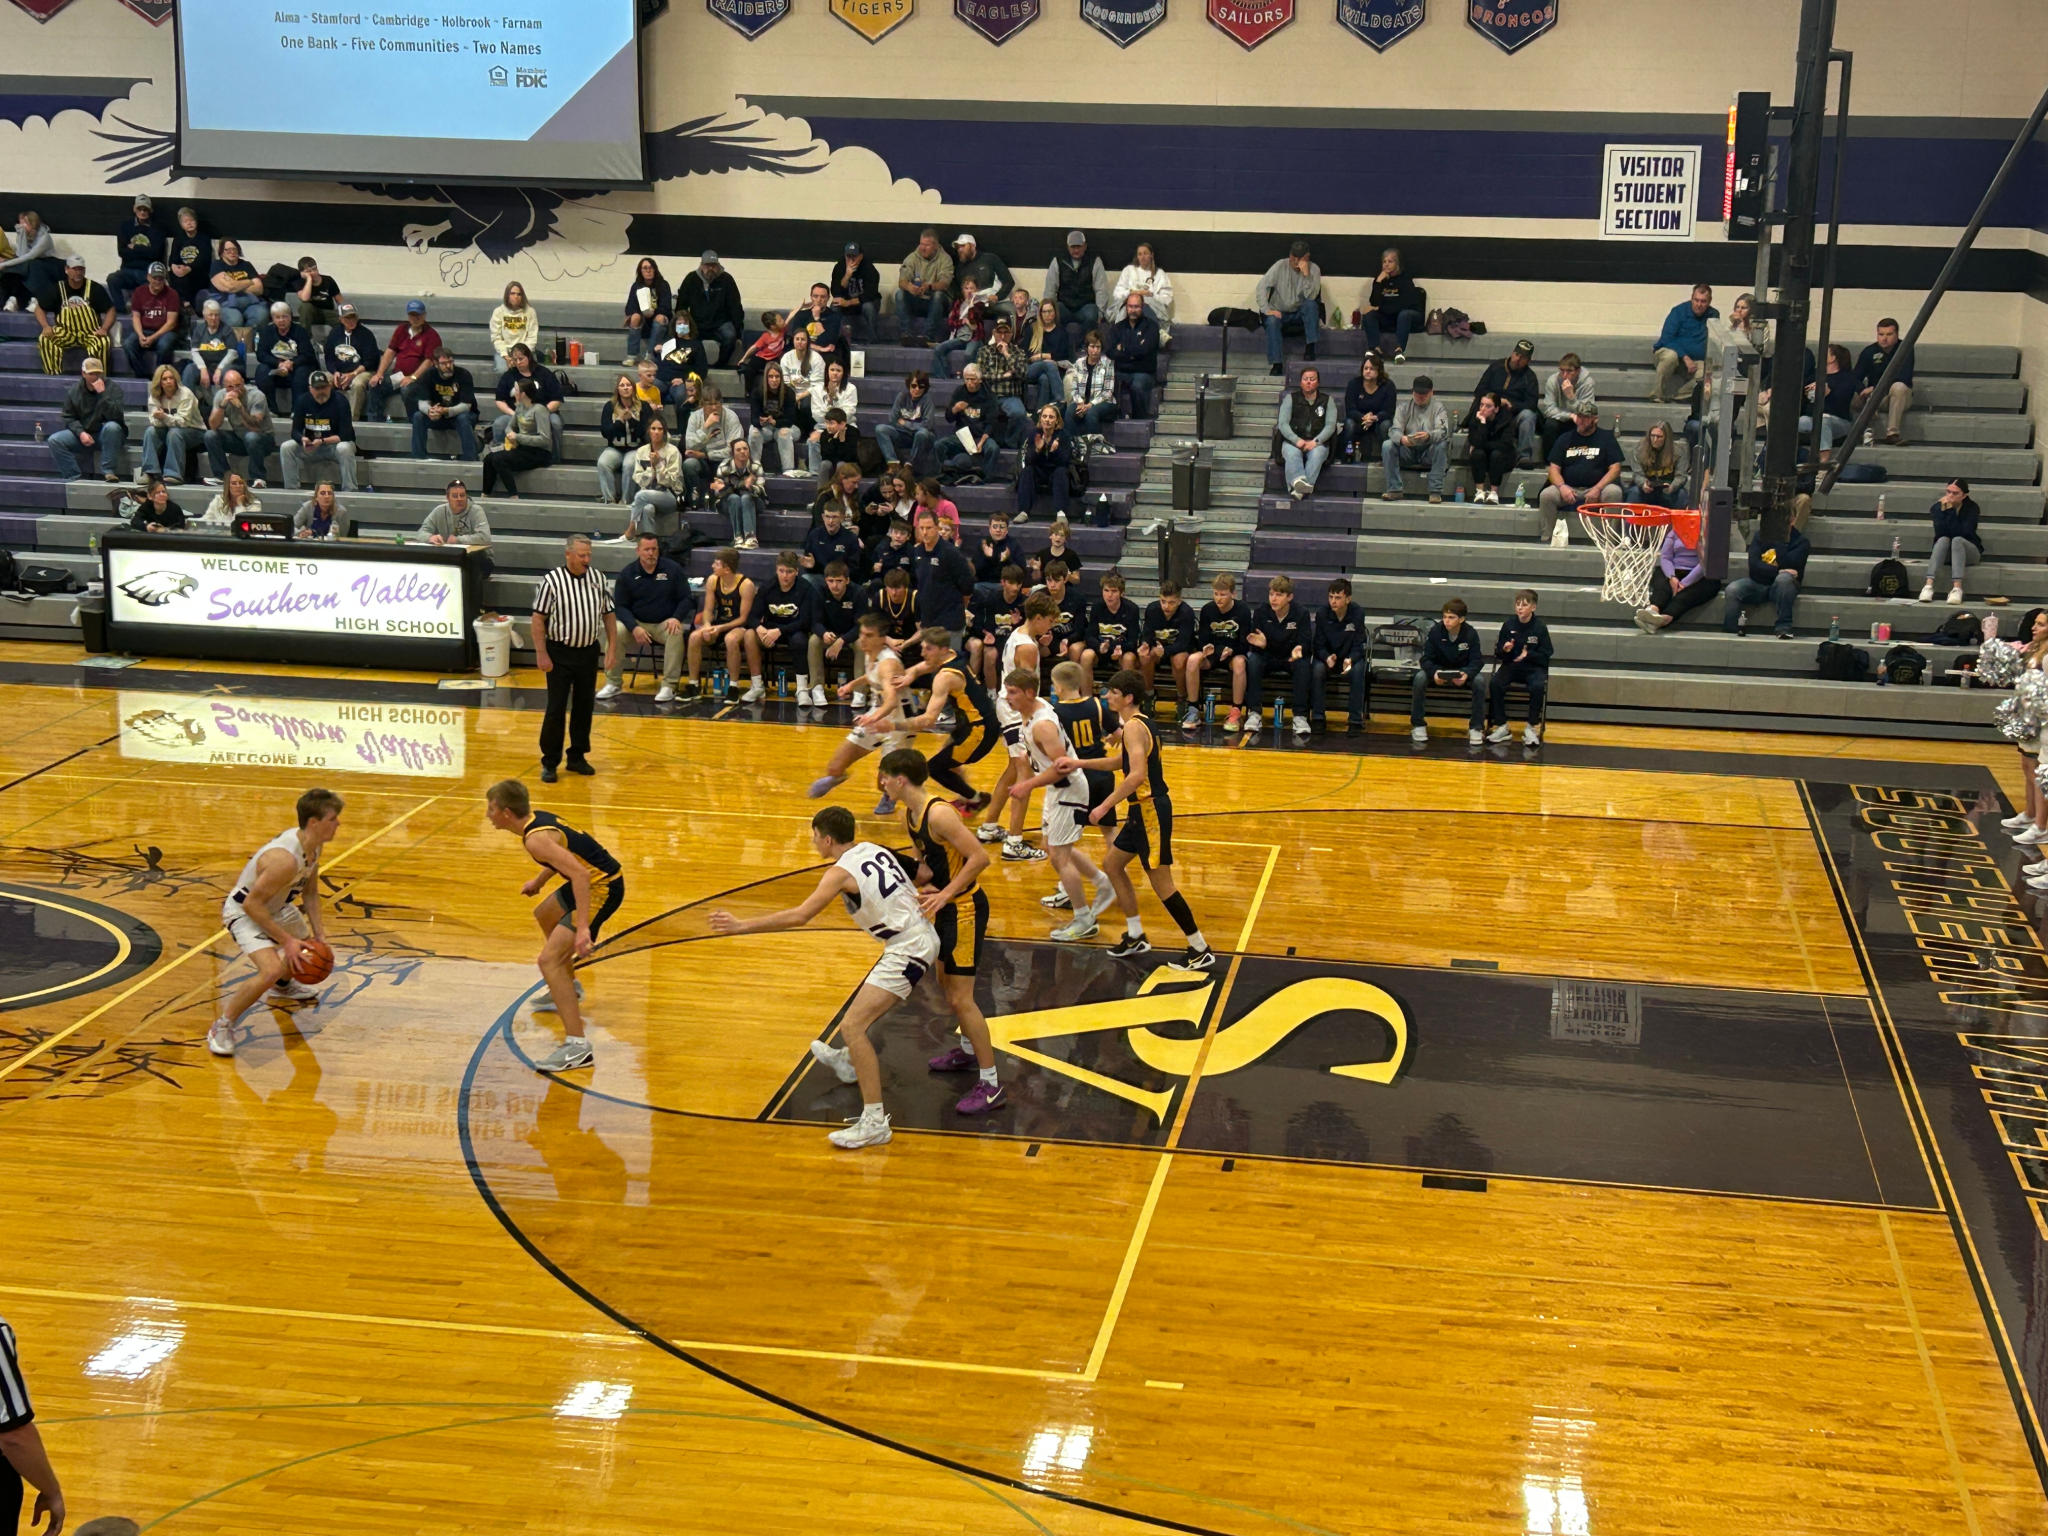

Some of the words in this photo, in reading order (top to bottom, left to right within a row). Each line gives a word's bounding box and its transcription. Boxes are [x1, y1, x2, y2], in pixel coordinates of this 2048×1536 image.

[715, 0, 785, 15] RAIDERS
[842, 0, 904, 15] TIGERS
[966, 0, 1032, 19] EAGLES
[1218, 6, 1284, 24] SAILORS
[1342, 4, 1422, 28] WILDCATS
[1473, 5, 1554, 28] BRONCOS
[274, 11, 300, 24] Alma
[311, 13, 361, 25] Stamford
[372, 14, 430, 28] Cambridge
[442, 15, 491, 29] Holbrook
[502, 17, 542, 30] Farnam
[281, 36, 304, 49] One
[308, 36, 338, 50] Bank
[351, 37, 376, 50] Five
[379, 38, 460, 53] Communities
[473, 40, 496, 55] Two
[501, 41, 542, 55] Names
[516, 75, 548, 88] FDIC
[1620, 156, 1684, 177] VISITOR
[1614, 183, 1686, 204] STUDENT
[1615, 209, 1681, 230] SECTION
[201, 557, 289, 575] WELCOME
[295, 562, 318, 576] TO
[207, 582, 341, 621] Southern
[351, 573, 451, 609] Valley
[335, 617, 380, 632] HIGH
[385, 619, 460, 635] SCHOOL
[1072, 719, 1094, 748] 10
[861, 851, 906, 899] 23
[1850, 784, 2048, 1004] SOUTHERN
